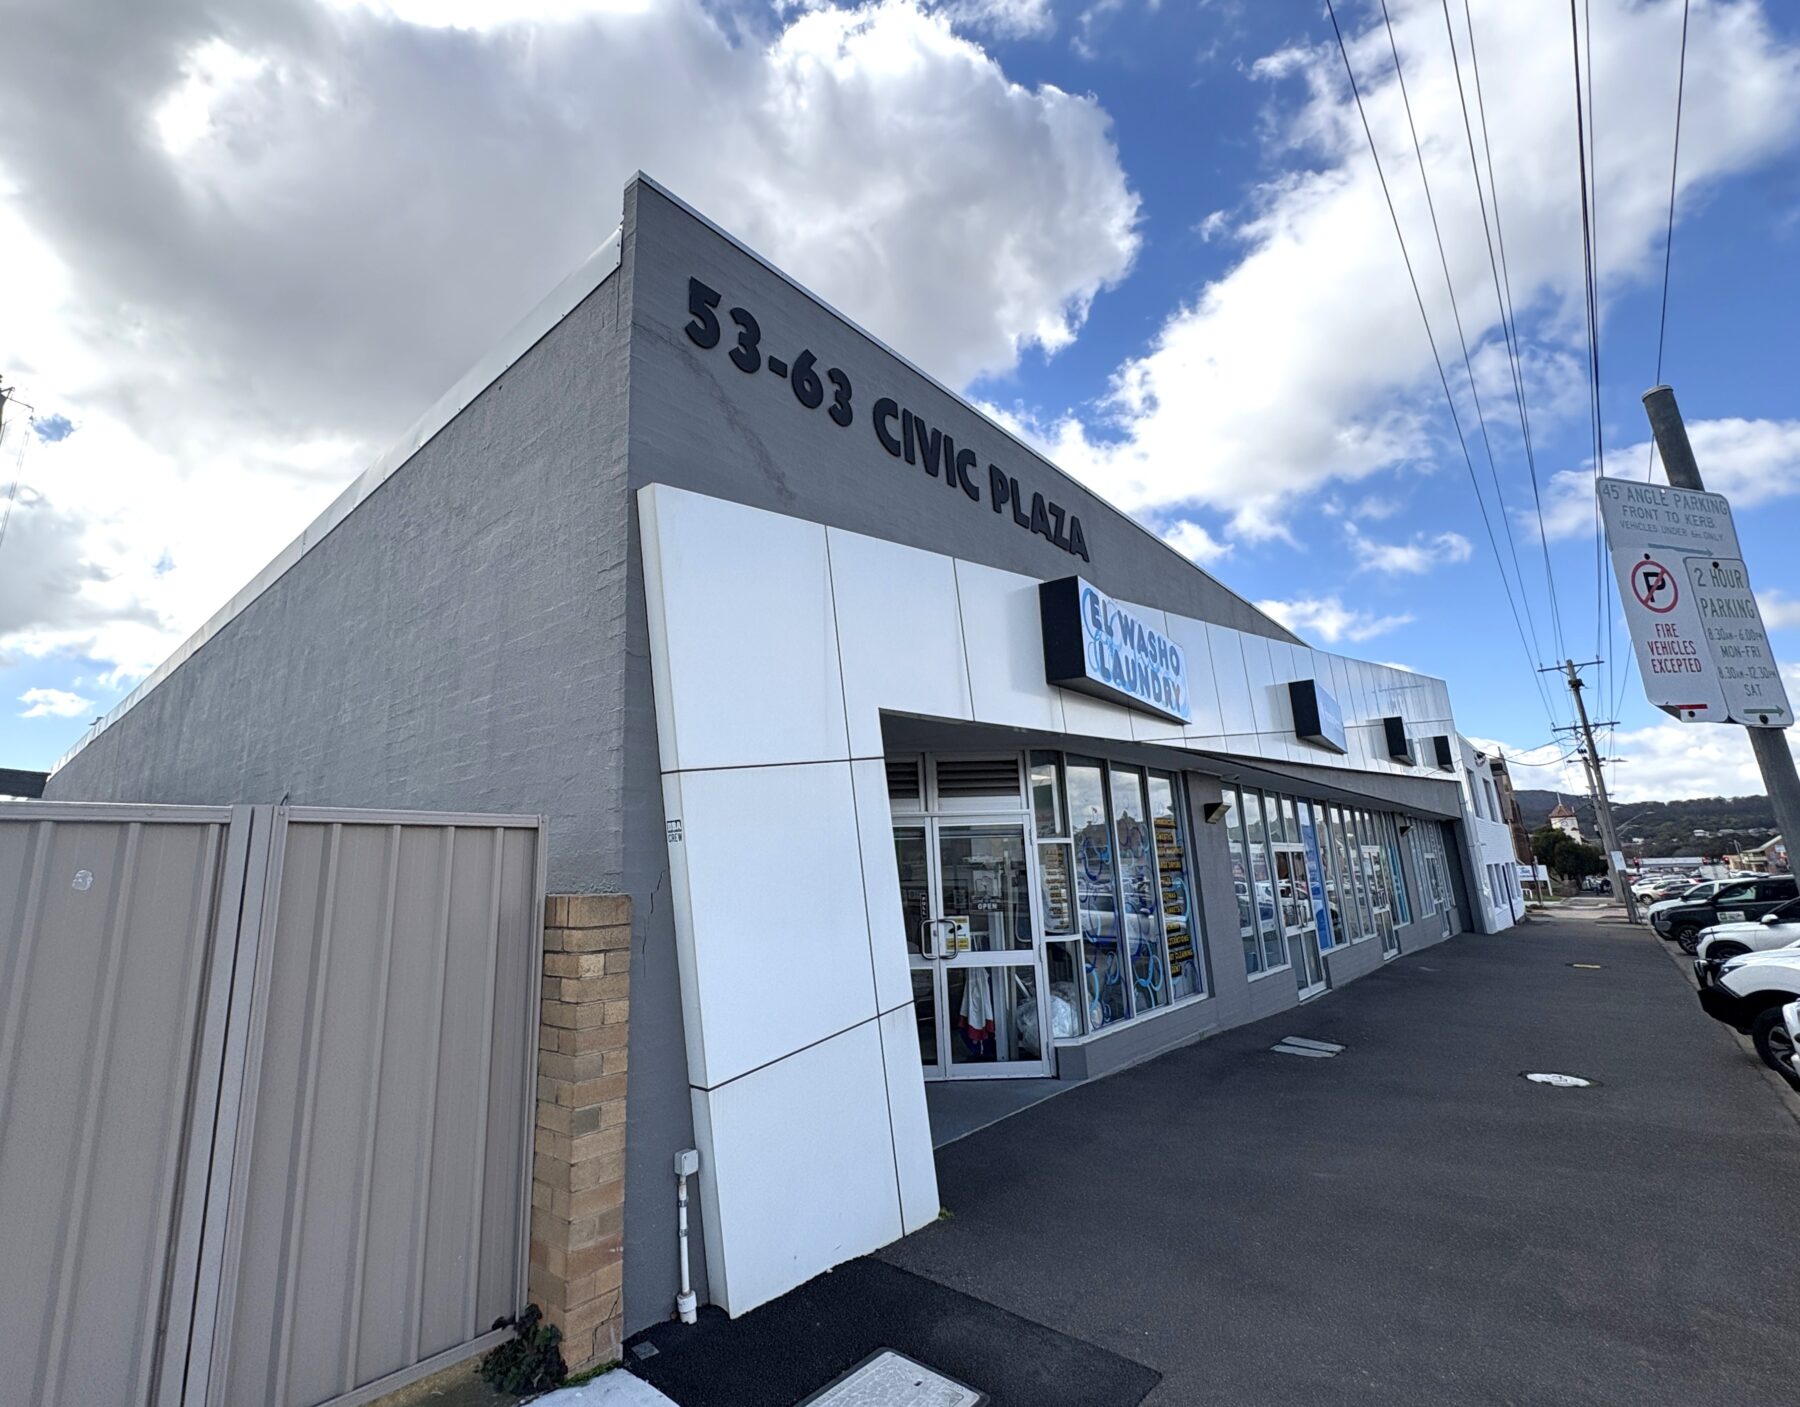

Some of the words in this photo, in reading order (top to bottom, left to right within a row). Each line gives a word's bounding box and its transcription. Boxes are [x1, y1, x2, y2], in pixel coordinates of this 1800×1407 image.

[684, 276, 854, 428] 53-63
[872, 397, 980, 502] CIVIC
[988, 463, 1091, 563] PLAZA
[1627, 486, 1669, 507] ANGLE
[1673, 493, 1729, 516] PARKING
[1619, 520, 1658, 533] VEHICLES
[1622, 504, 1660, 521] FRONT
[1665, 511, 1680, 524] TO
[1684, 513, 1716, 529] KERB
[1694, 568, 1707, 588] 2
[1709, 568, 1744, 589] HOUR
[1700, 597, 1756, 619] PARKING
[1655, 623, 1680, 638] FIRE
[1116, 609, 1181, 677] WASHO
[1647, 640, 1697, 656] VEHICLES
[1720, 645, 1762, 658] MON-FRI
[1651, 658, 1702, 673] EXCEPTED
[1098, 640, 1182, 713] LAUNDRY
[1744, 683, 1762, 697] SAT
